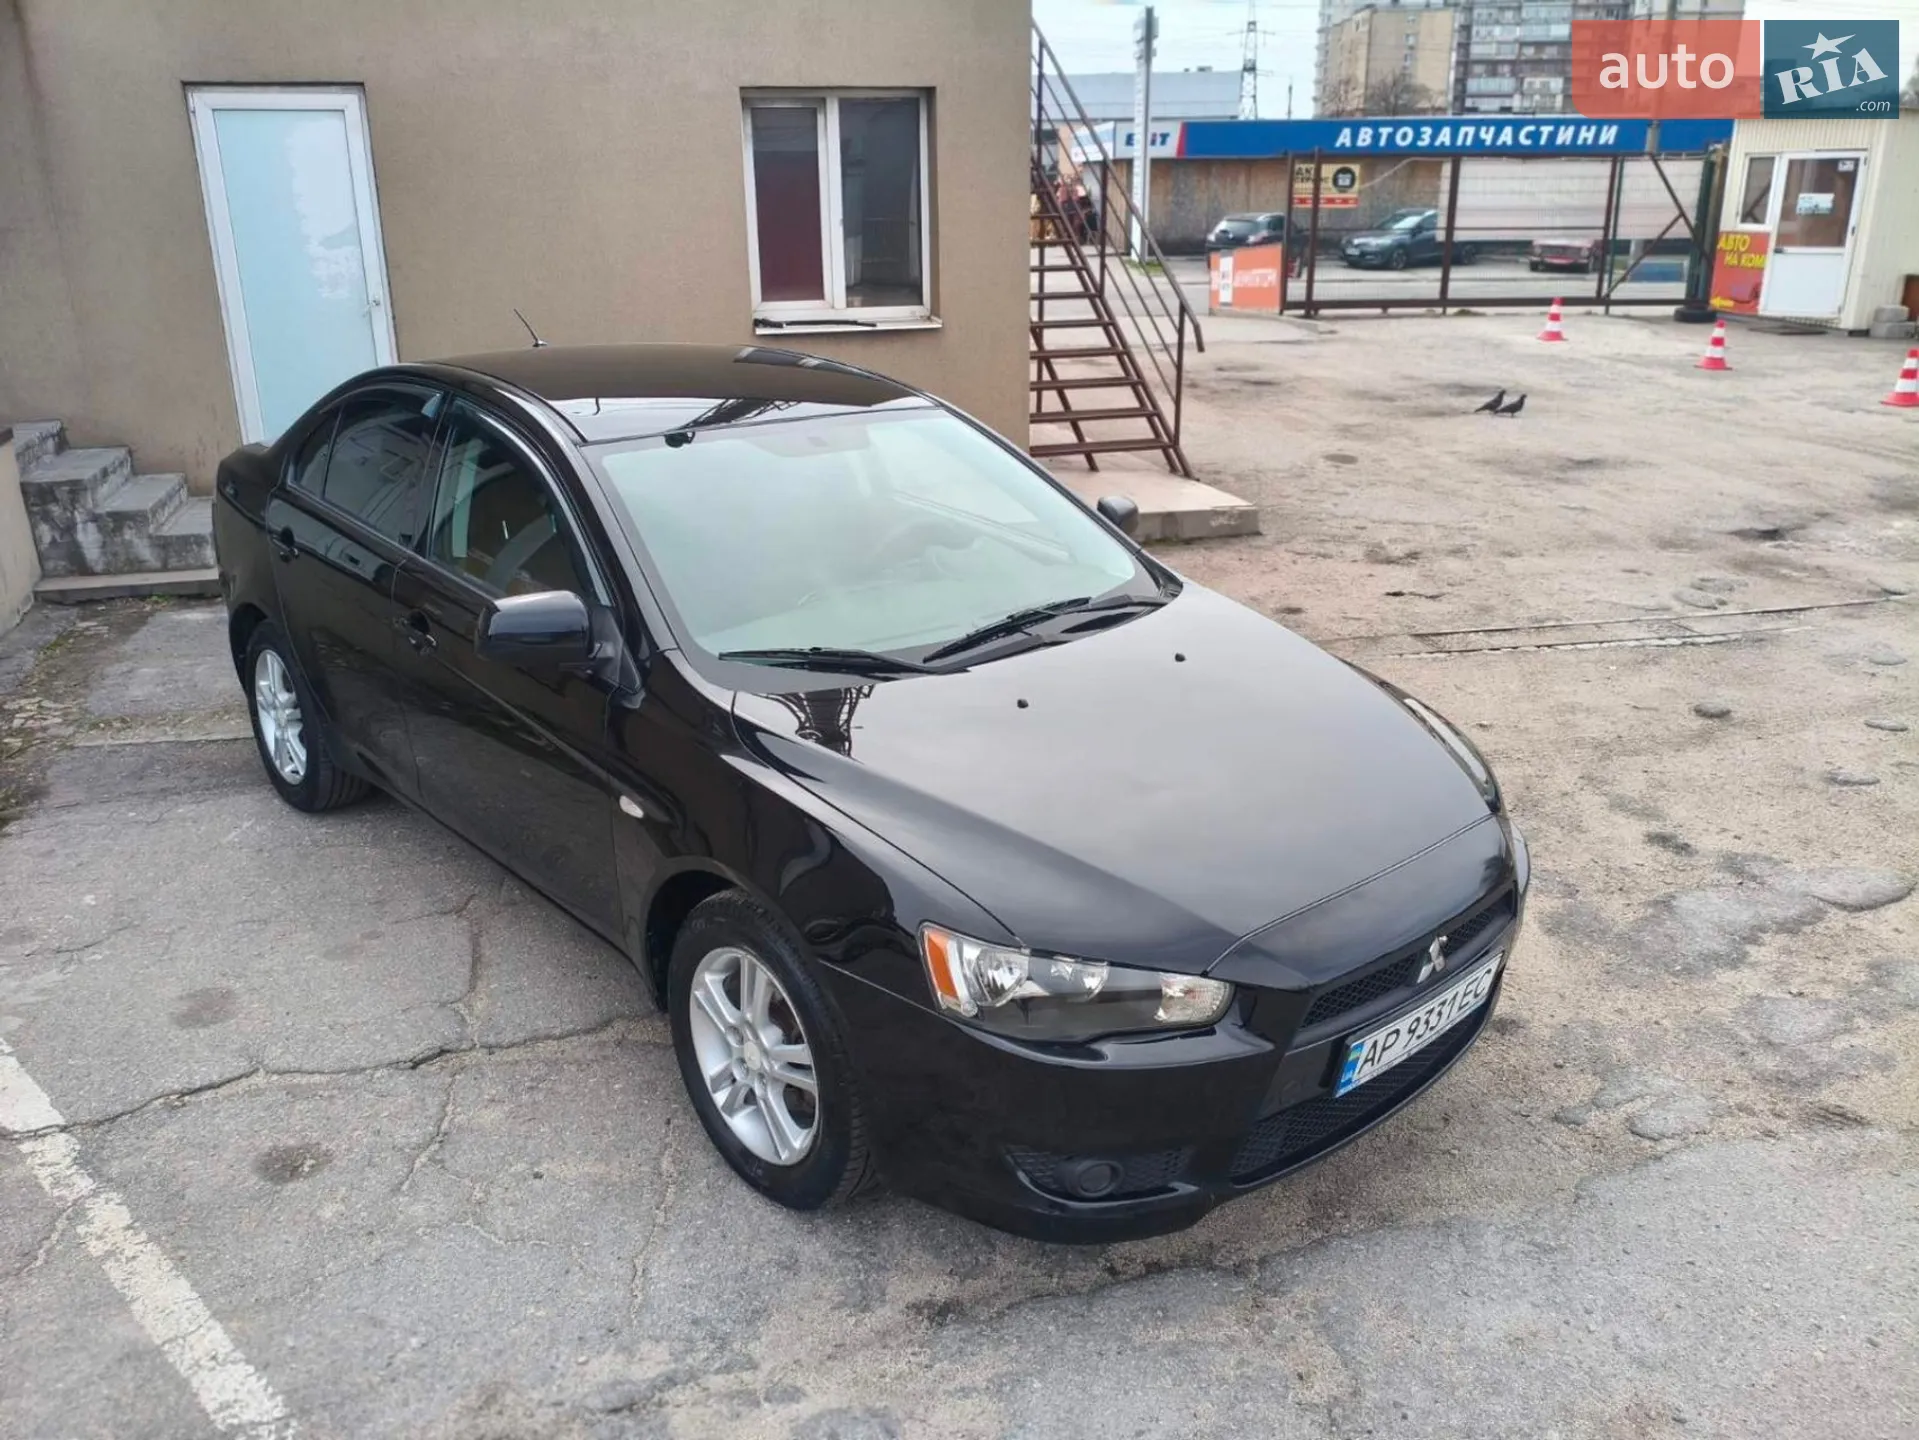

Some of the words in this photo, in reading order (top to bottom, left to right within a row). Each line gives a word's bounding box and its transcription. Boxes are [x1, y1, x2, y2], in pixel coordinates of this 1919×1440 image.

[1335, 125, 1619, 148] АВТОЗАПЧАСТИНИ
[1717, 234, 1751, 252] АВТО
[1357, 1028, 1401, 1074] AP
